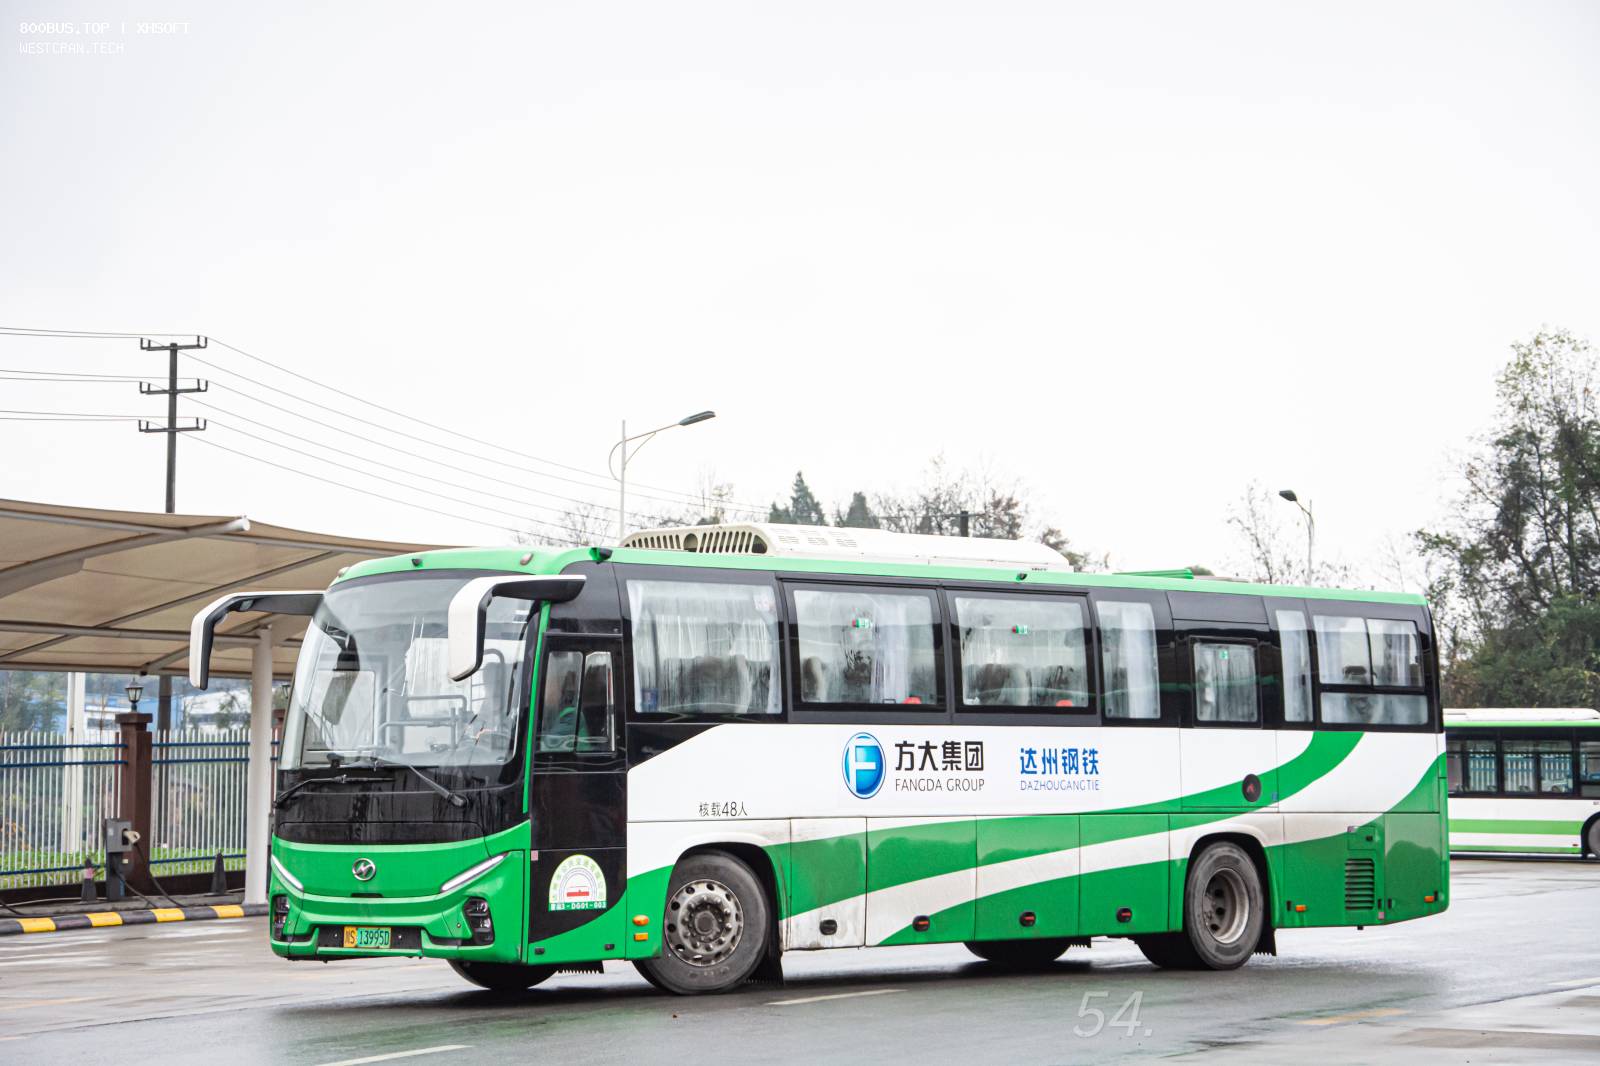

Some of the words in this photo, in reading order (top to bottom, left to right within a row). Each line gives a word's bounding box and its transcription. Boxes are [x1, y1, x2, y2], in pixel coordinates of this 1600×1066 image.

[895, 740, 985, 772] 方大集团
[1019, 747, 1099, 775] 达州钢铁
[895, 778, 942, 792] FANGDA
[946, 778, 985, 792] GROUP
[1020, 779, 1100, 791] DAZHOUGANGTIE
[698, 801, 748, 817] 核载48人
